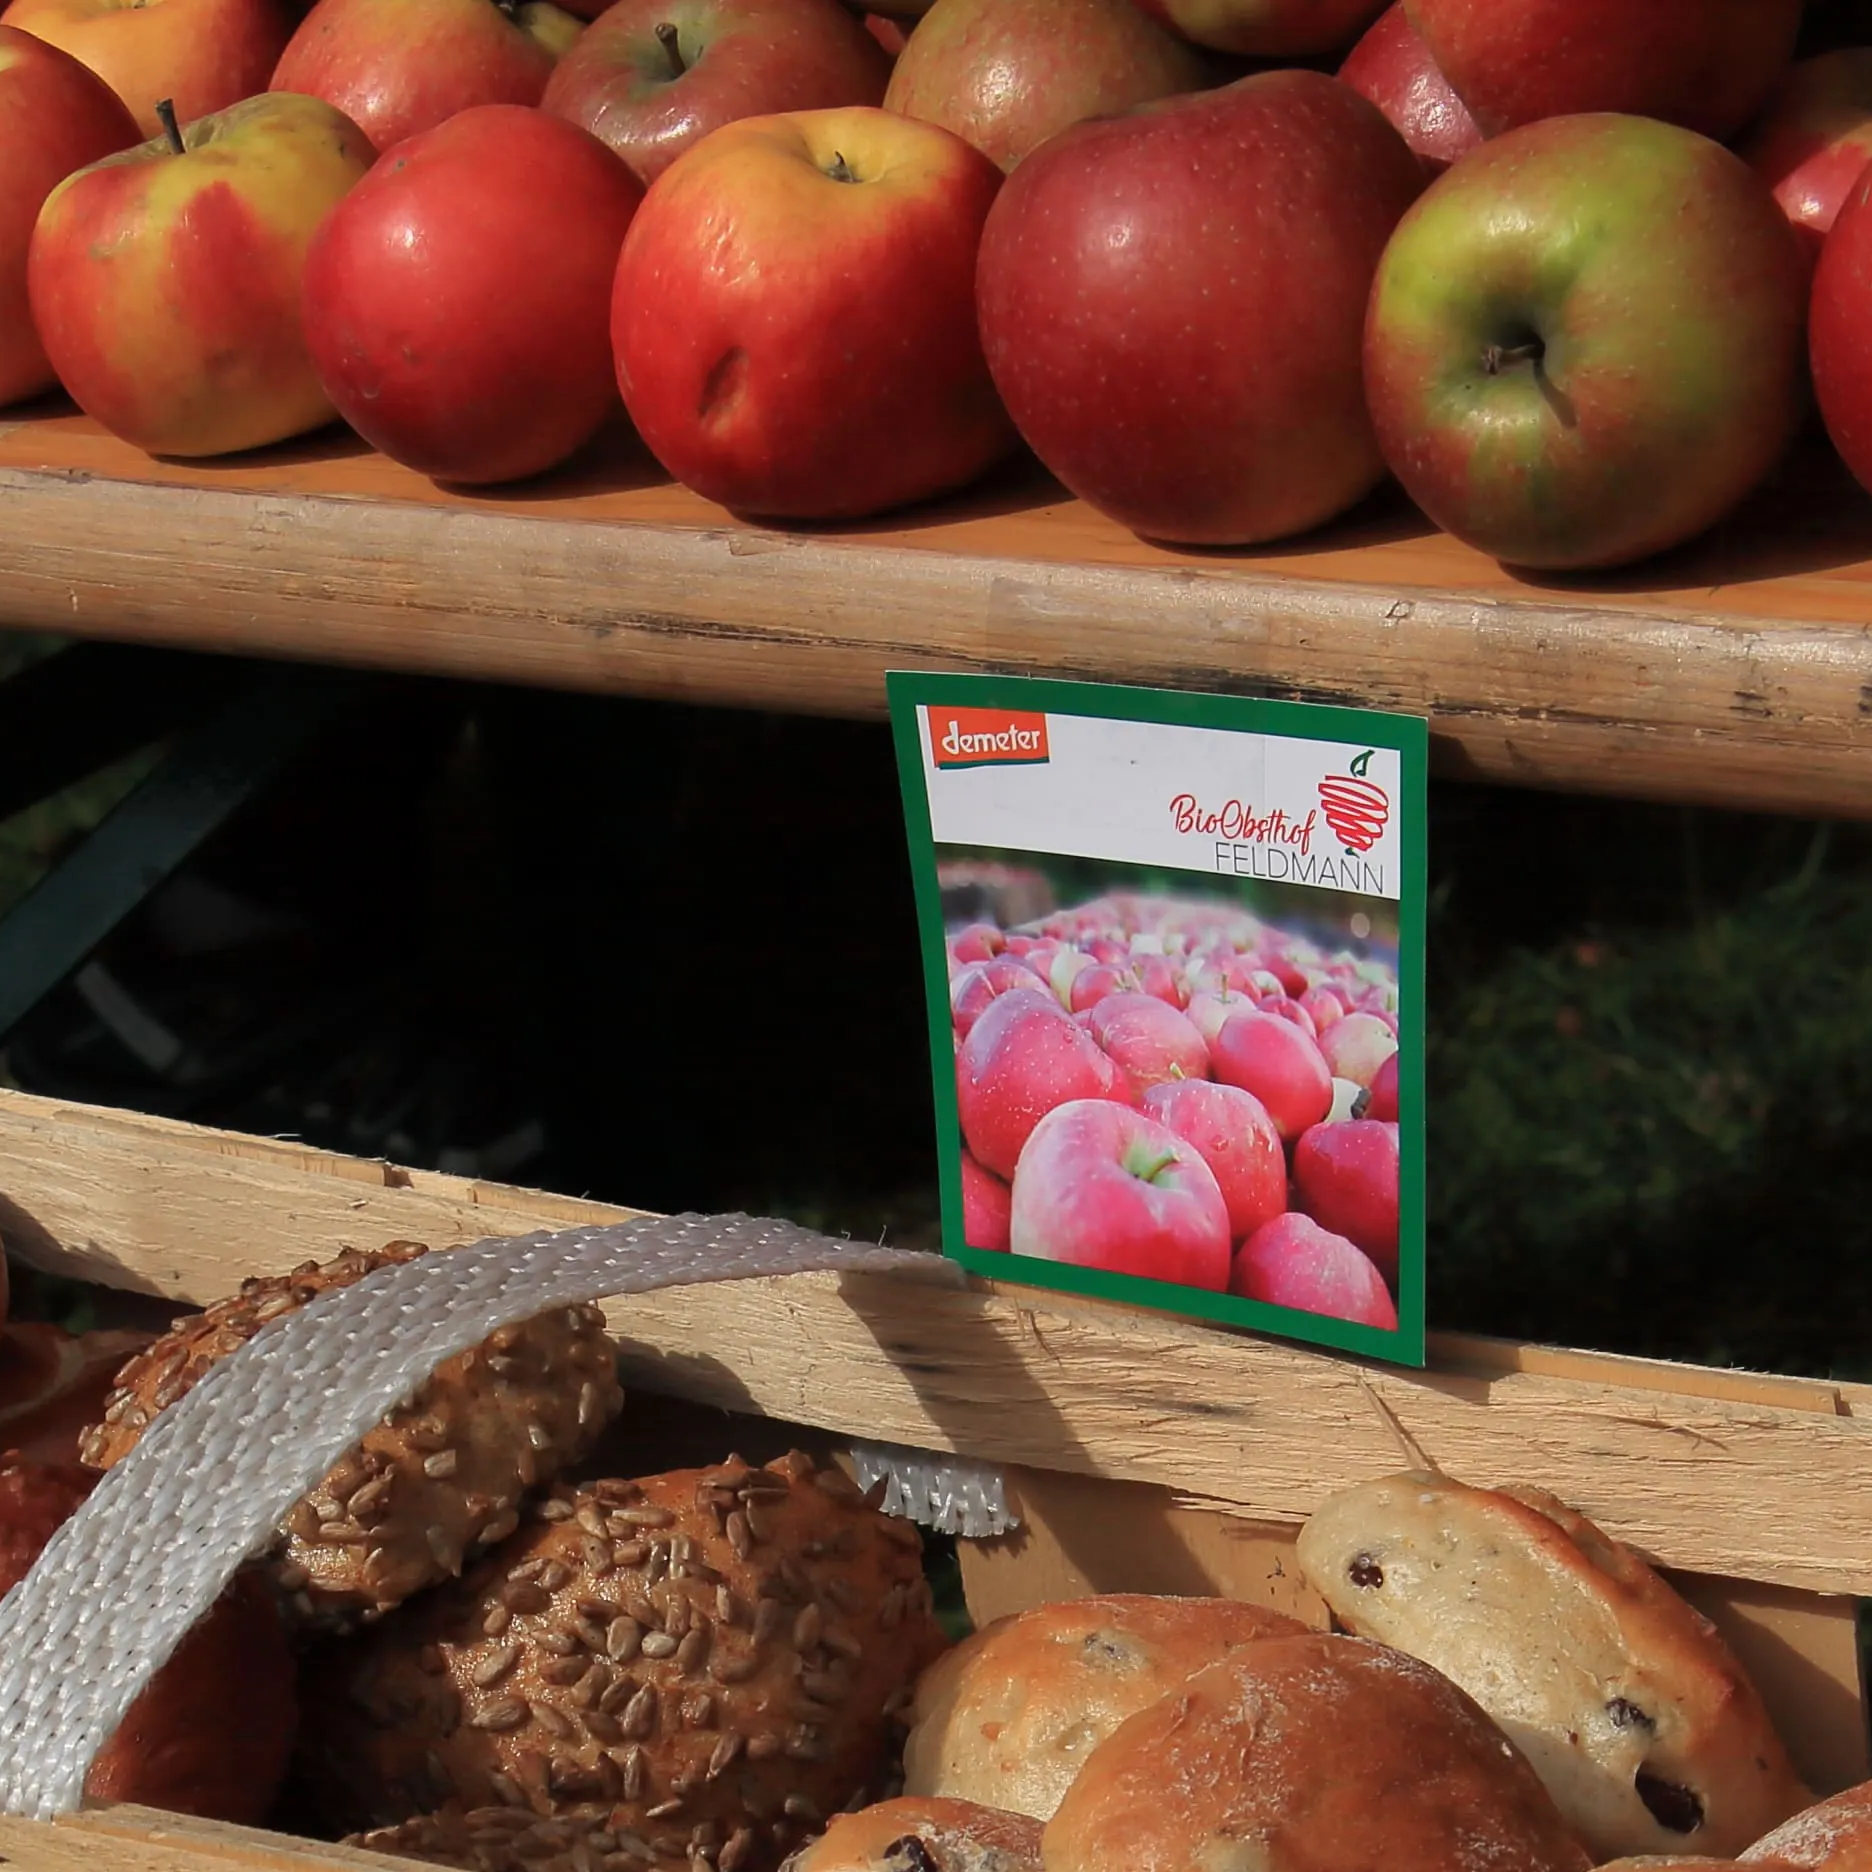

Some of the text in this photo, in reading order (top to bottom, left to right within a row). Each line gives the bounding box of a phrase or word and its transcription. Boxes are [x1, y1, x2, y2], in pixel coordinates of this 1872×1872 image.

[941, 721, 1041, 754] demeter
[1169, 794, 1317, 856] BioObsthof
[1216, 841, 1384, 895] FELDMANN
